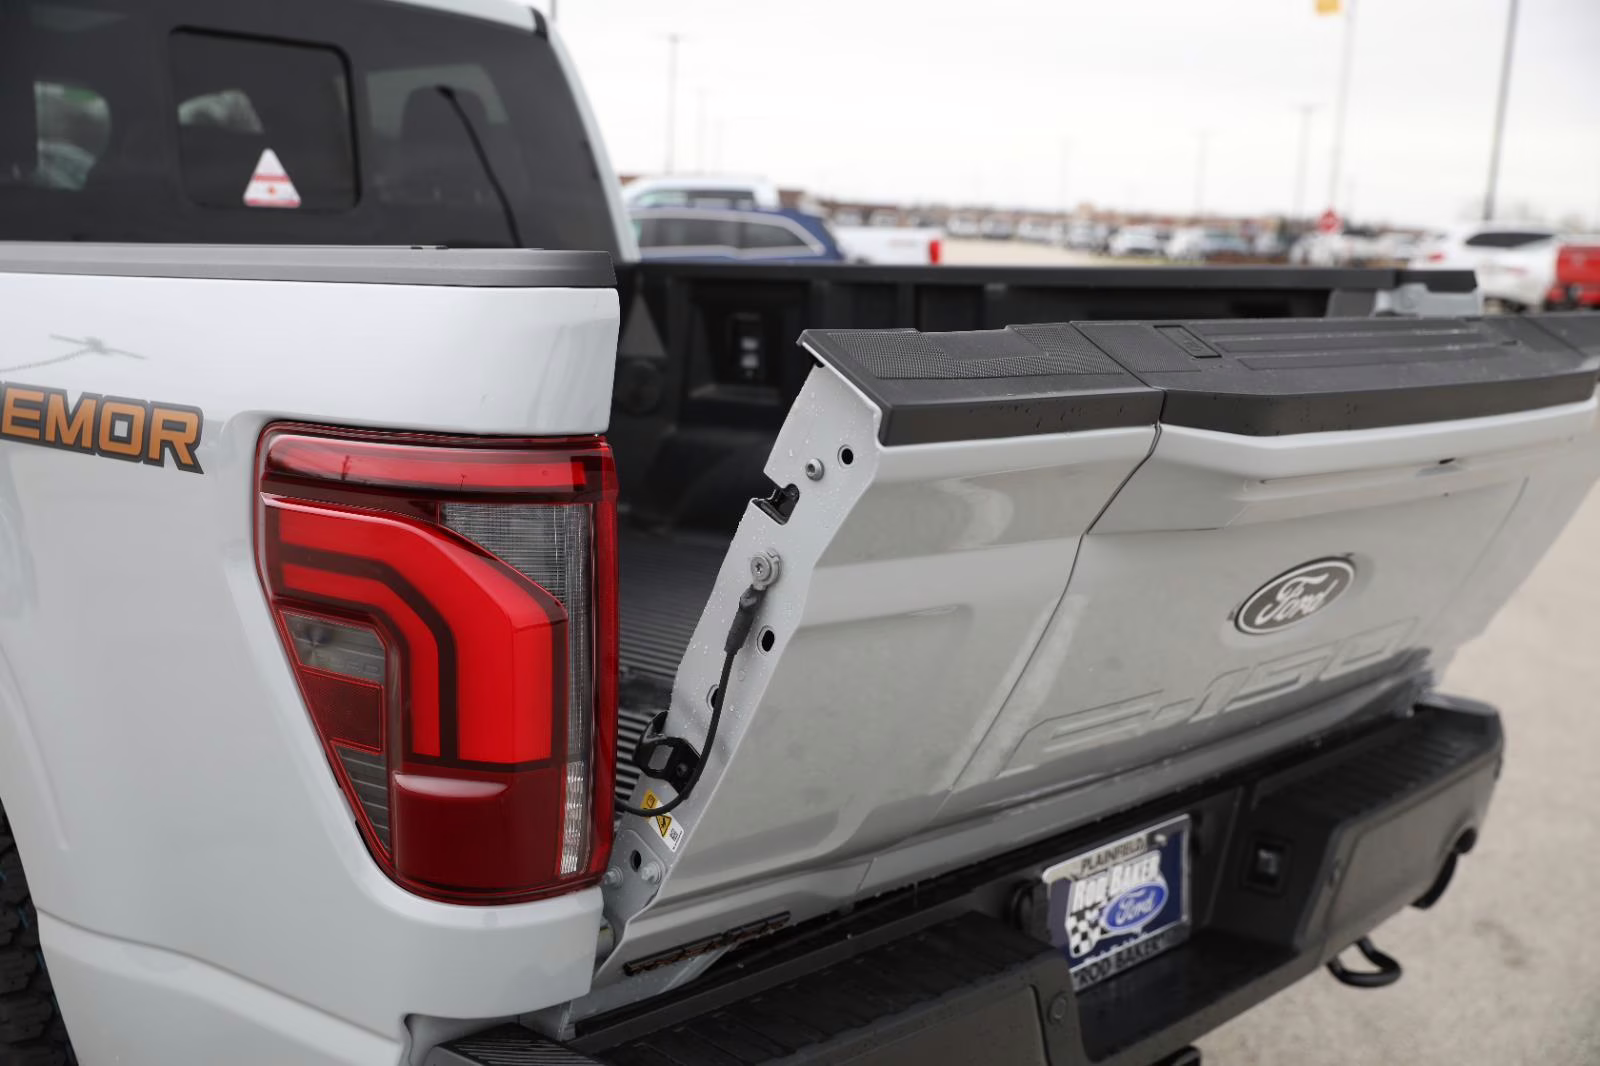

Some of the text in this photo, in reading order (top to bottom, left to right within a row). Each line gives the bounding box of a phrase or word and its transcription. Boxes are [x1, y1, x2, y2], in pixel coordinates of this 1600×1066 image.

[1253, 571, 1340, 627] Ford
[1080, 837, 1146, 875] PLAINFIELD
[1113, 888, 1157, 926] Ford
